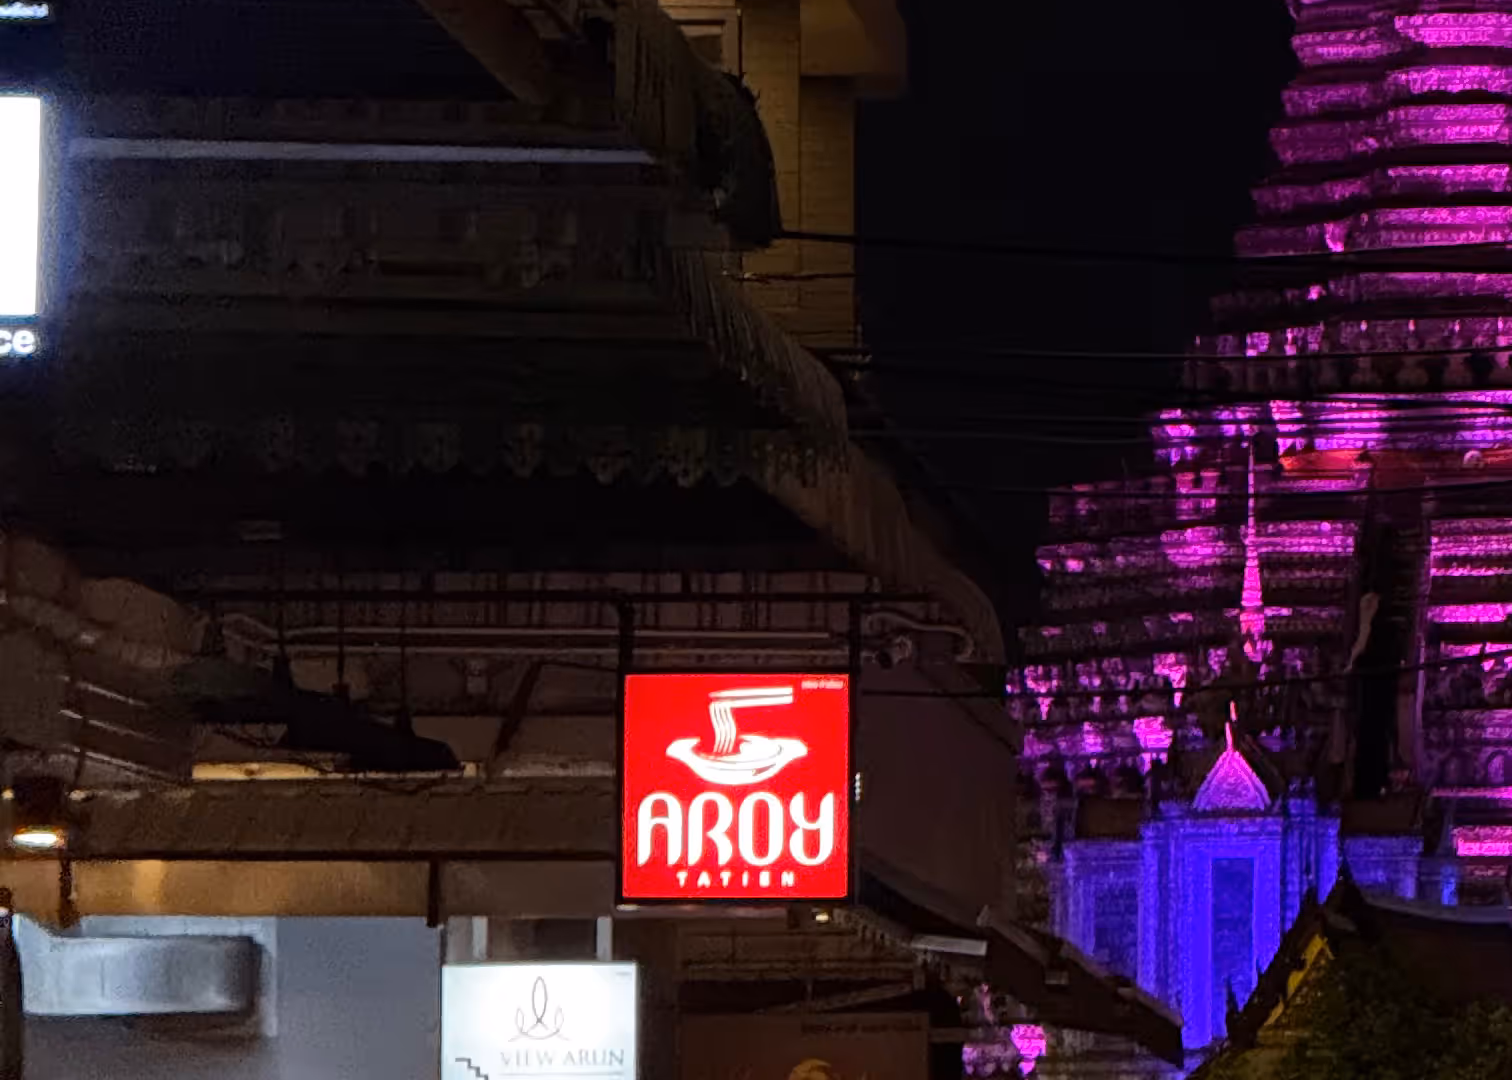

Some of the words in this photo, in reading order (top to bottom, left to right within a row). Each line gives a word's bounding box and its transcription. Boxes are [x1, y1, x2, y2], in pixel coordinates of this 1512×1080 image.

[637, 791, 834, 867] AROY
[676, 871, 795, 888] TATIEN
[500, 1049, 555, 1066] VIEW
[562, 1048, 625, 1066] ARUN
